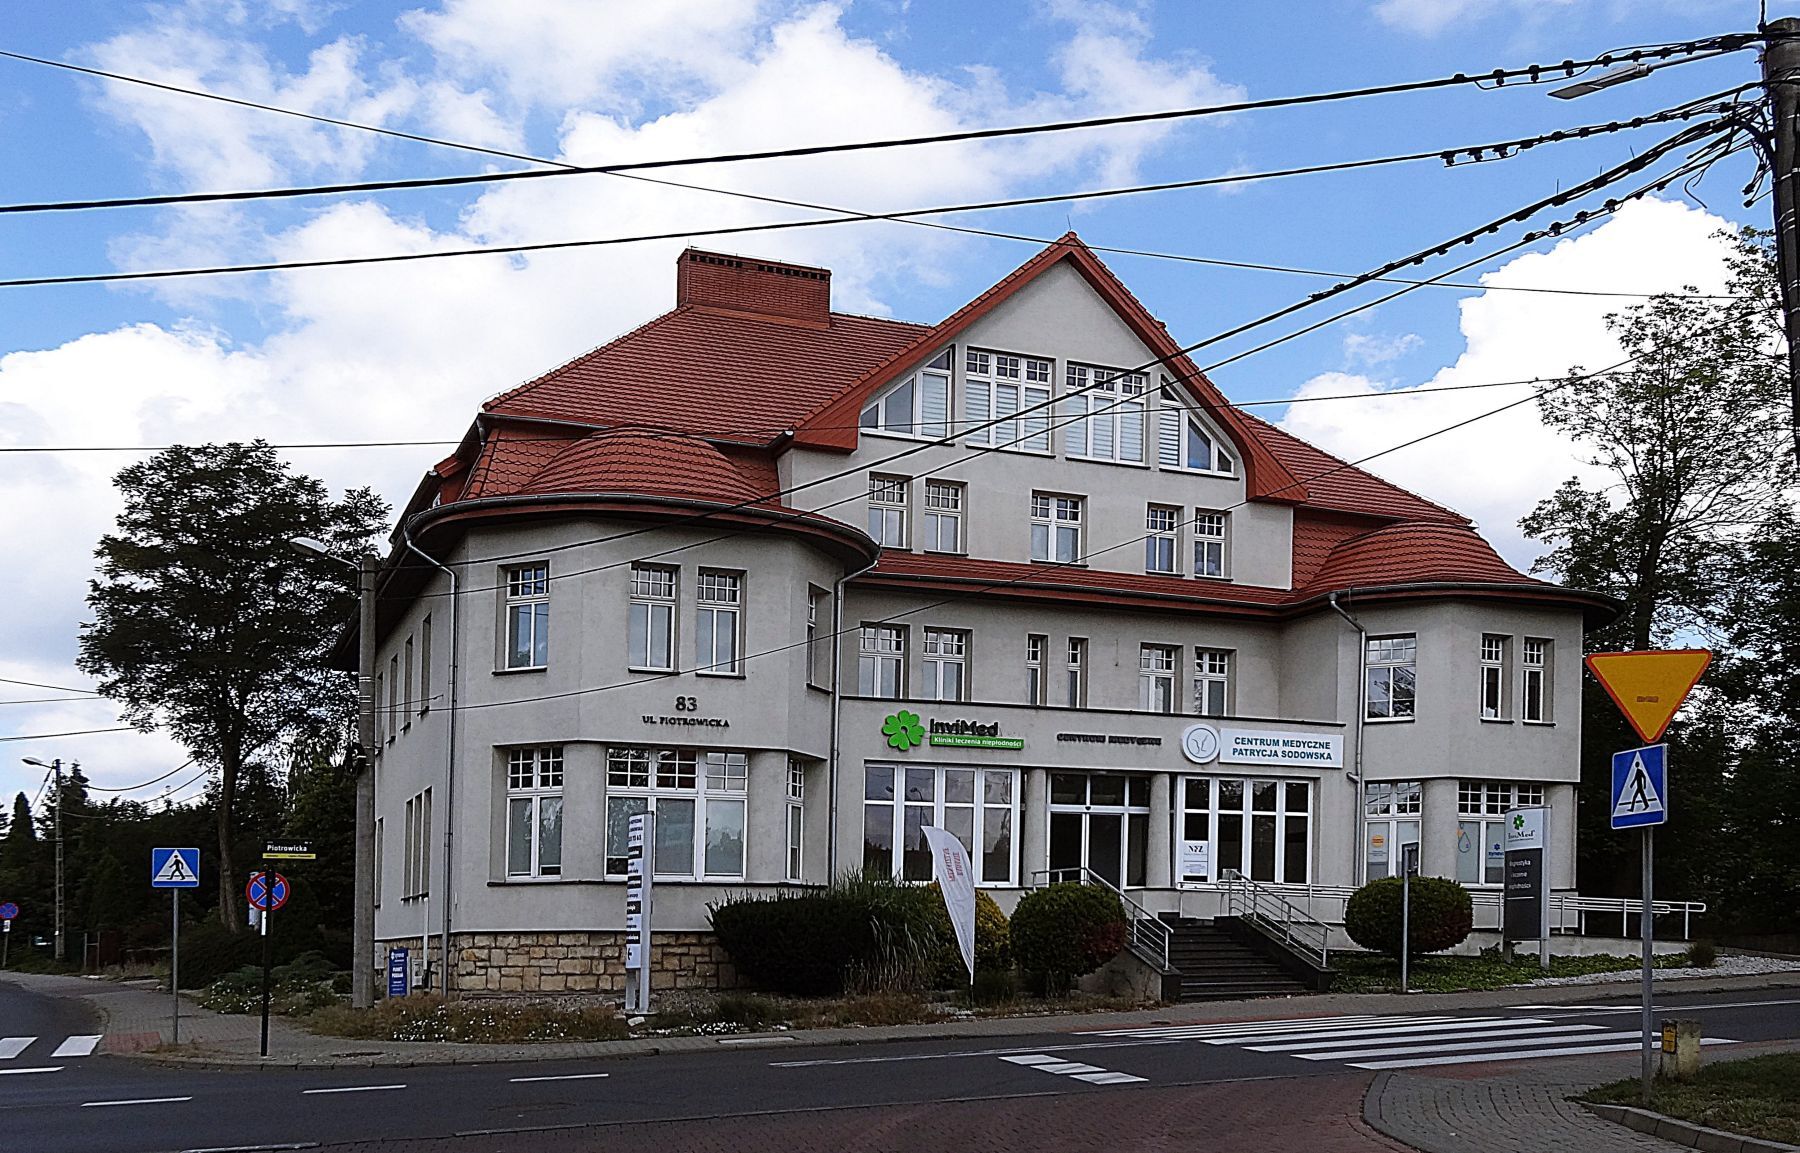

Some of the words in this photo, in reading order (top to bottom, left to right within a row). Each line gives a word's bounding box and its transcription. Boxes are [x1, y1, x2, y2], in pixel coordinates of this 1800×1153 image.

[675, 696, 698, 712] 83
[641, 715, 657, 725] UL
[659, 716, 730, 728] PIOTROWICKA
[929, 718, 999, 737] InviMed
[955, 738, 981, 746] leczenia
[982, 739, 1022, 748] niepłodności
[1234, 736, 1280, 747] CENTRUM
[1282, 739, 1331, 750] MEDYCZNE
[1232, 747, 1279, 758] PATRYCJA
[1281, 750, 1332, 761] SODOWSKA
[266, 844, 308, 852] Piotrowicka
